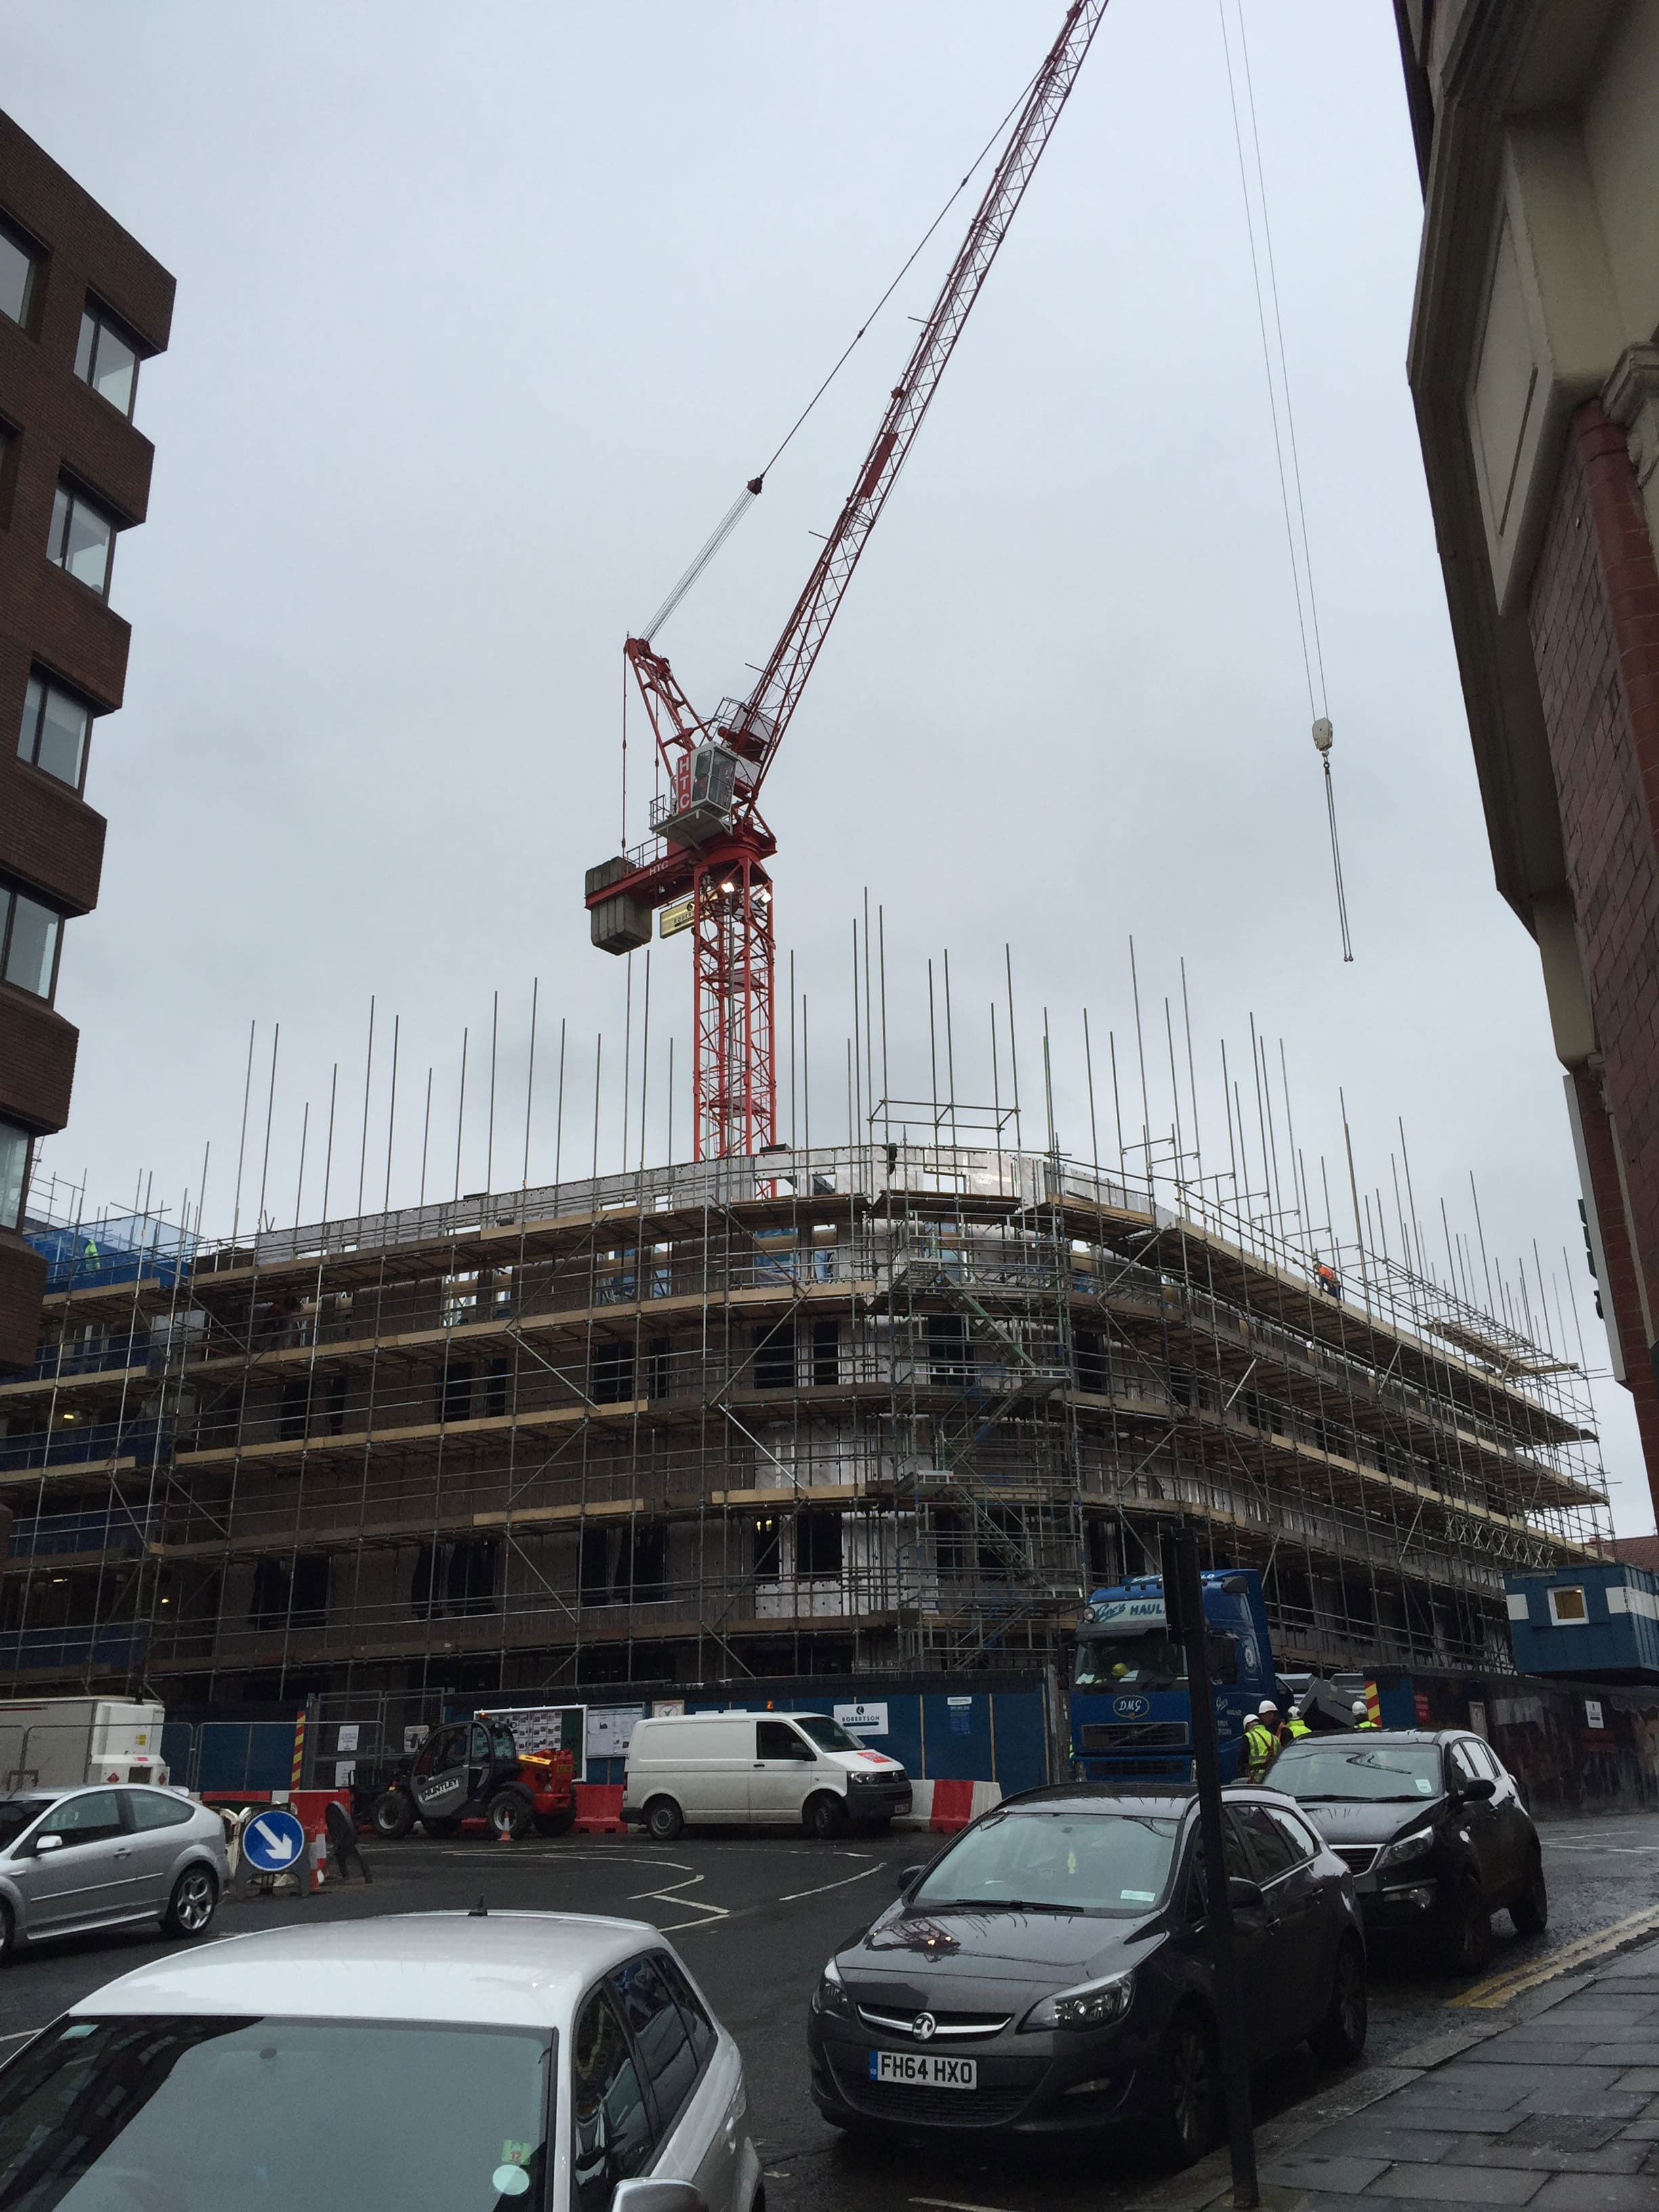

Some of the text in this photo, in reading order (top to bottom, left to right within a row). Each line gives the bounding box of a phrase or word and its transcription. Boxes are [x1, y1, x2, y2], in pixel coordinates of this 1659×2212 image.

[680, 757, 690, 808] HTC
[649, 860, 669, 876] HTC
[674, 911, 695, 924] ROBERT
[1130, 1603, 1165, 1616] HAUL
[1118, 1700, 1143, 1712] DMG
[423, 1778, 457, 1799] HUNTLEY
[881, 2054, 972, 2085] FH64 HXO
